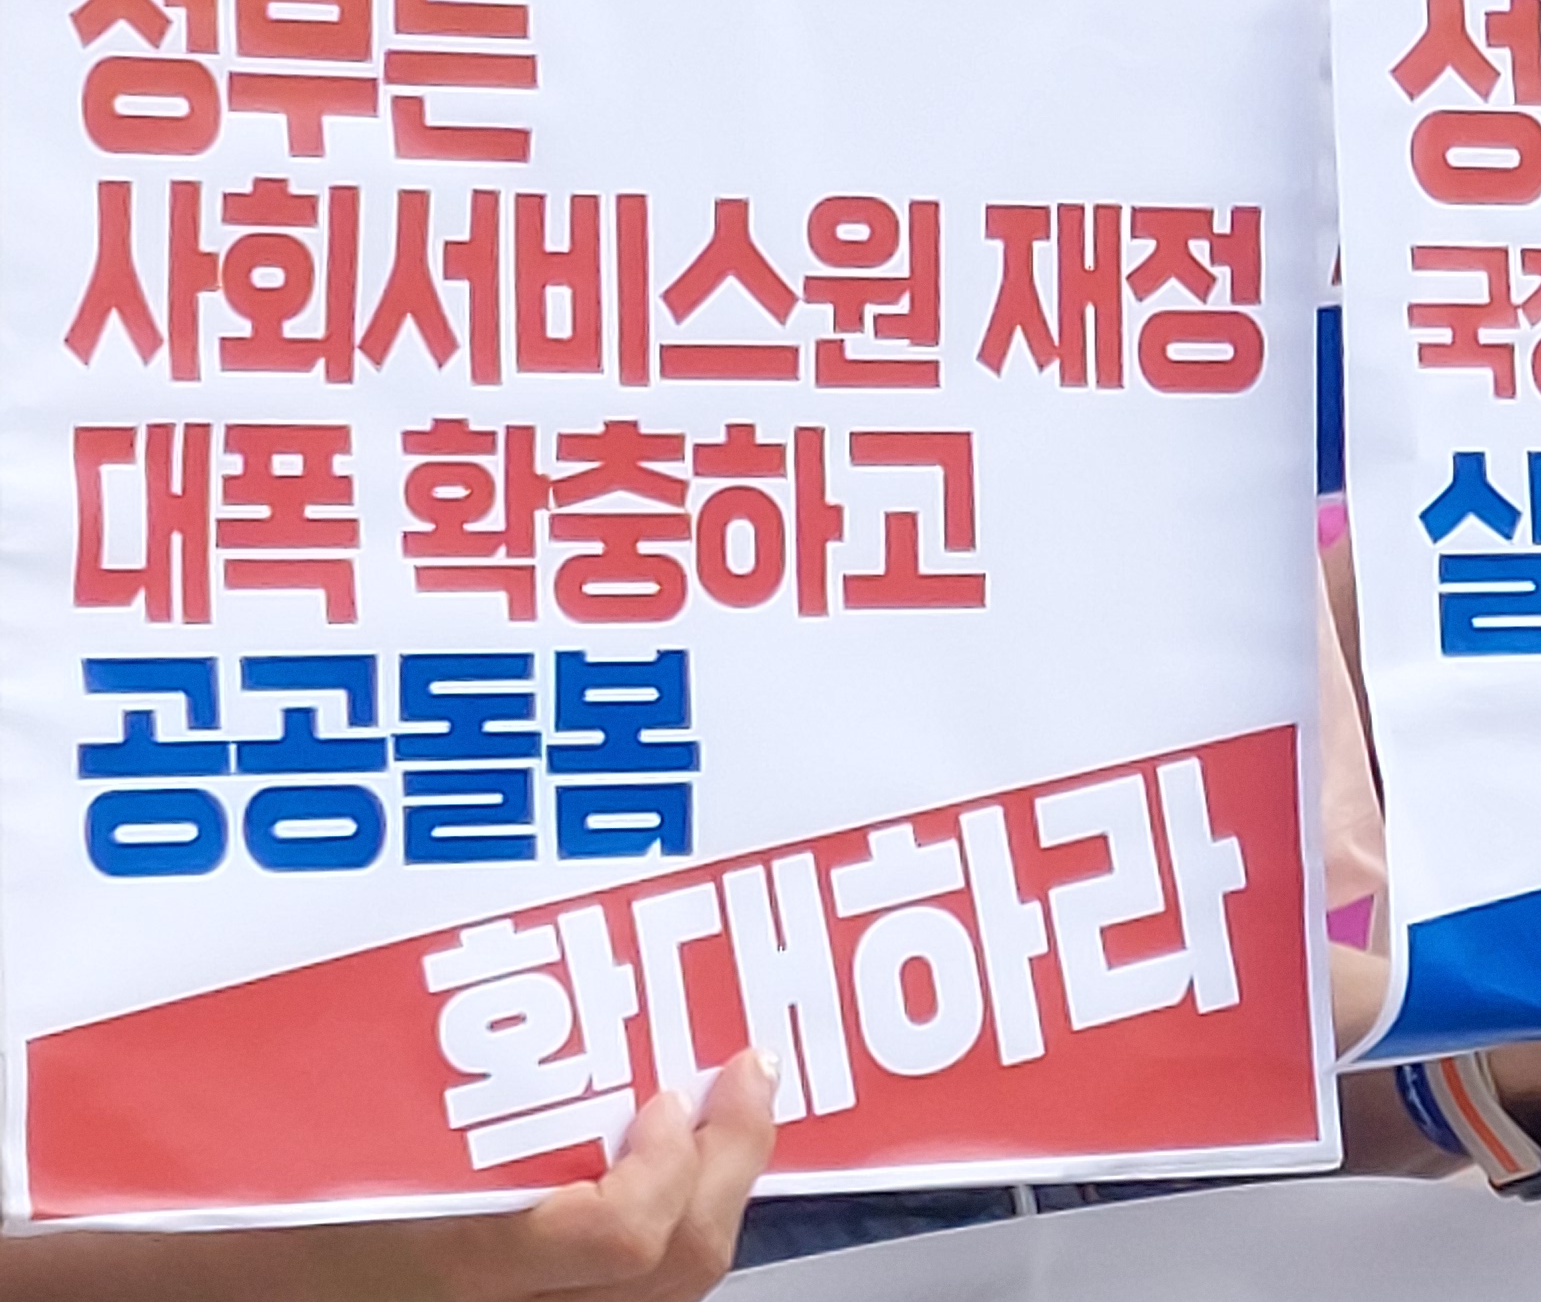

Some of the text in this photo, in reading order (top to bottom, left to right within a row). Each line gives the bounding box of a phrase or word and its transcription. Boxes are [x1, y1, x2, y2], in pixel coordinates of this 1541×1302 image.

[64, 176, 1265, 394] 사회서비스원 재정
[72, 417, 988, 625] 대폭 확충하고
[75, 648, 701, 879] 공공돌봄
[421, 754, 1248, 1171] 확대하라
